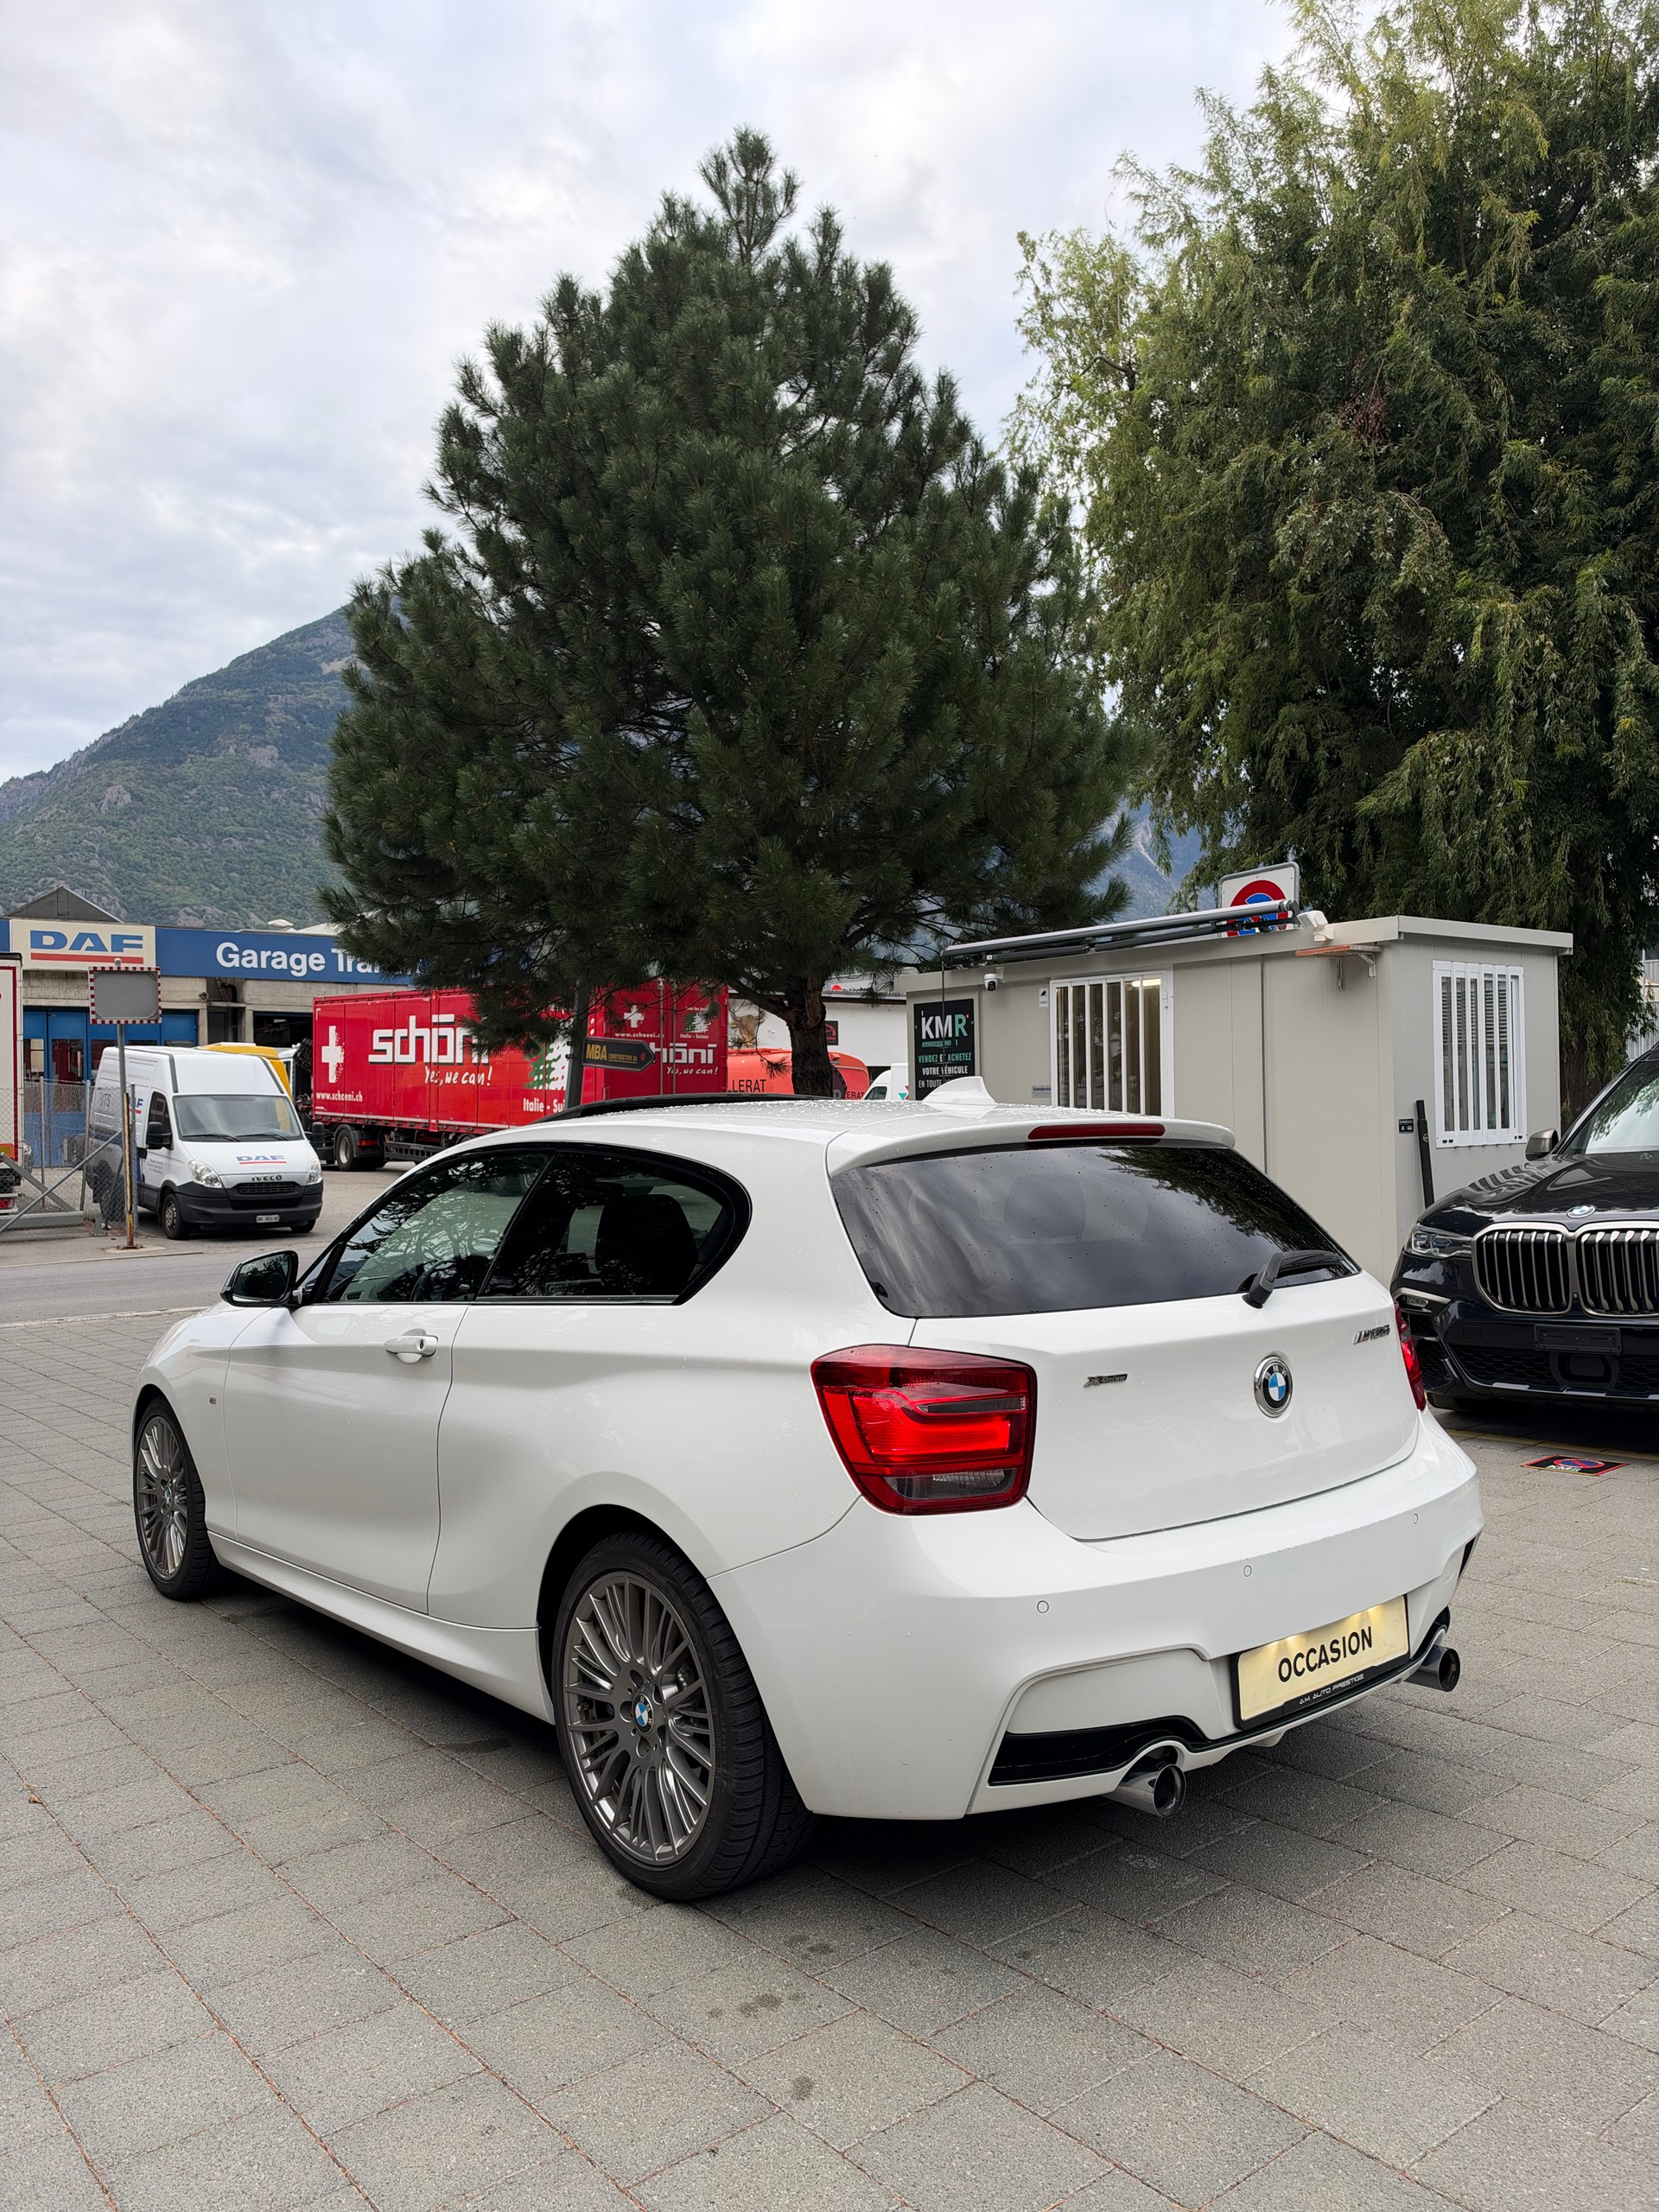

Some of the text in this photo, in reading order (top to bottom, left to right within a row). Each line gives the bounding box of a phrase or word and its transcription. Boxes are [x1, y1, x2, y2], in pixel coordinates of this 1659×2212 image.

[30, 931, 143, 952] DAF
[216, 942, 326, 977] Garage
[921, 1014, 968, 1039] KMR
[586, 1044, 607, 1061] MBA
[947, 1052, 972, 1062] ACHETEZ
[461, 1065, 493, 1087] can!
[696, 1066, 719, 1075] can!
[922, 1066, 940, 1075] VOTRE
[523, 1097, 544, 1113] Italie
[1278, 1626, 1372, 1682] OCCASION
[1299, 1673, 1364, 1705] AM AUTO PRESTIGE
